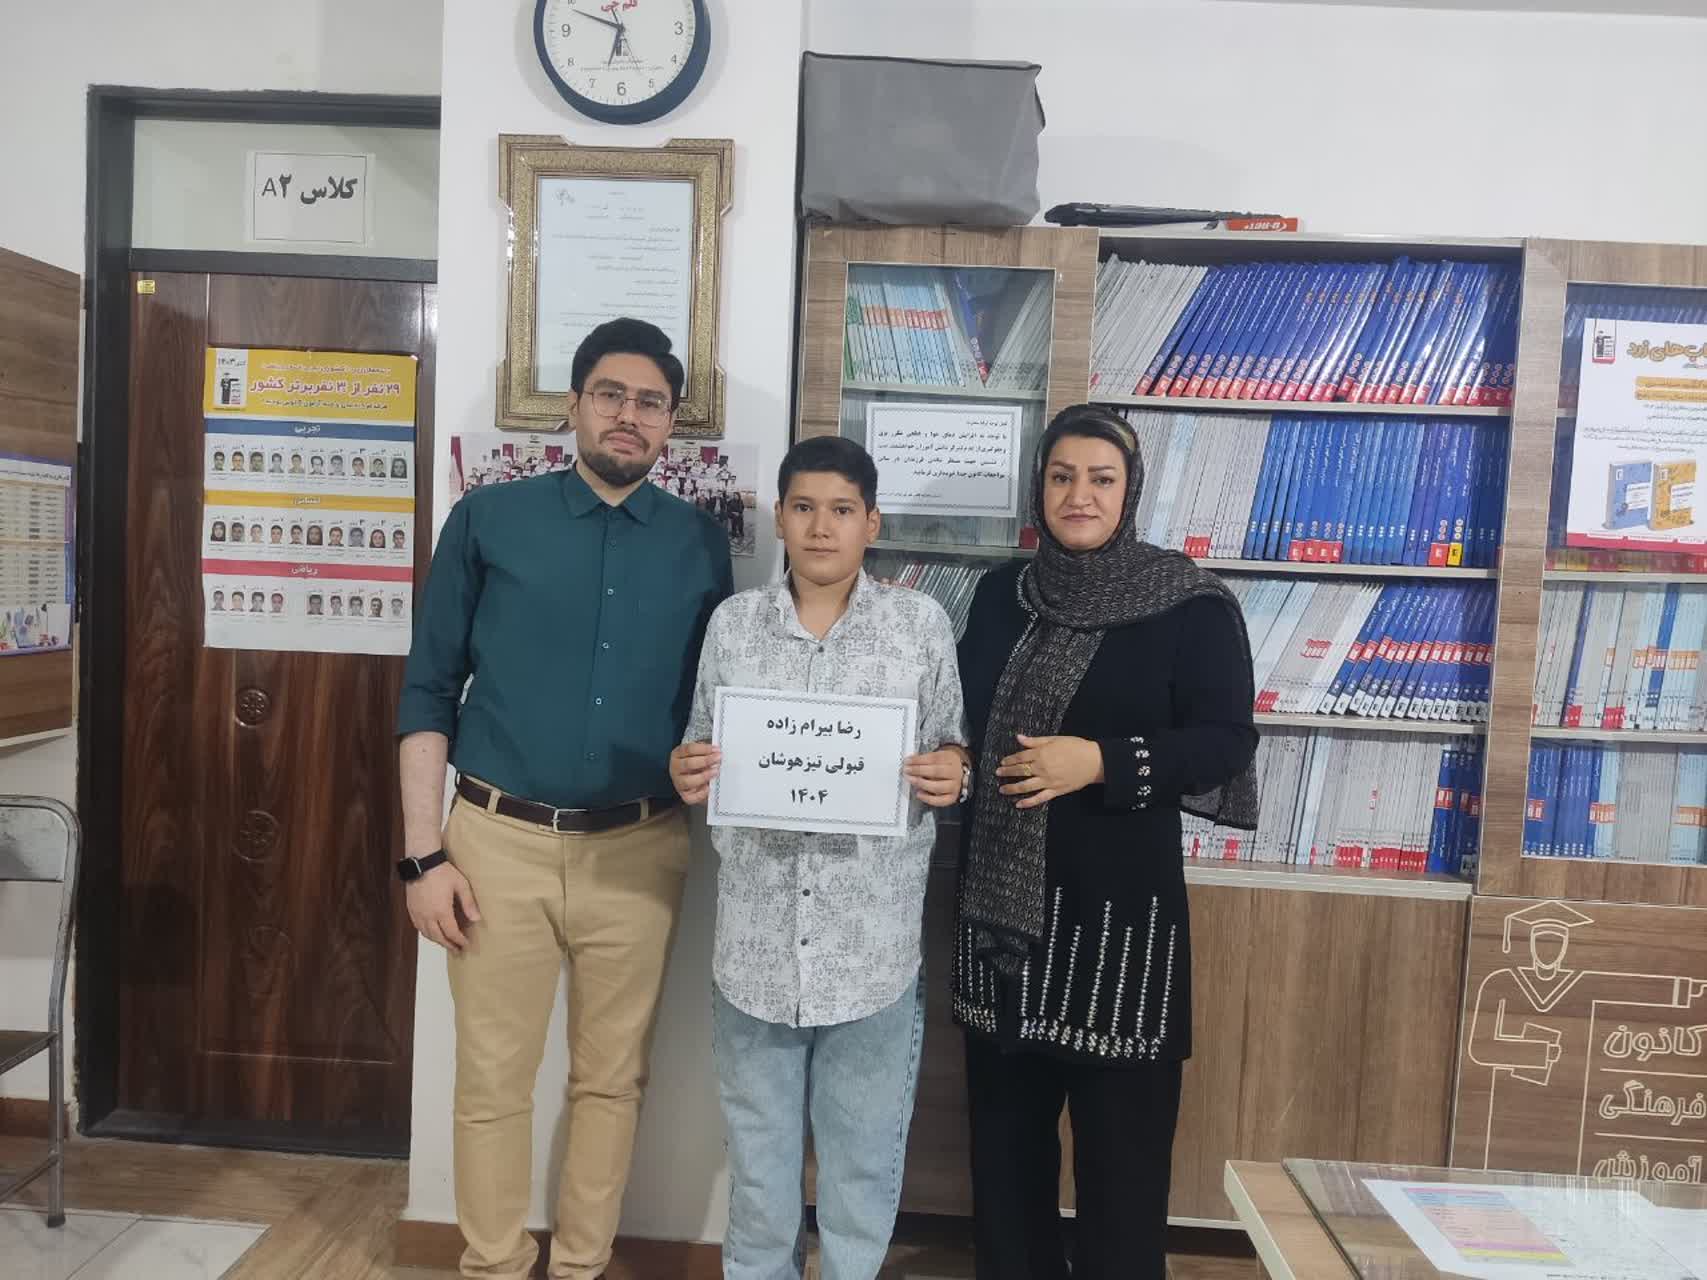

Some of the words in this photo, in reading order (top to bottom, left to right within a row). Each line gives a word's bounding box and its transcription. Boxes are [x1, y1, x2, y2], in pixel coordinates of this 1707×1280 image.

[561, 24, 572, 38] 9
[674, 22, 684, 36] 3
[567, 57, 575, 67] 8
[670, 54, 677, 65] 4
[589, 78, 596, 89] 7
[616, 81, 627, 97] 6
[300, 176, 358, 205] کلاس
[250, 377, 284, 392] کشور
[351, 381, 361, 396] از
[363, 383, 383, 396] نفر
[386, 383, 400, 395] ۲۹
[767, 716, 796, 735] زاده
[837, 721, 861, 739] رضا
[759, 752, 822, 772] تیزهوشان
[825, 757, 865, 775] قبولی
[791, 788, 829, 805] ۱۴۰۴
[1603, 1025, 1707, 1061] کانون
[1599, 1080, 1707, 1126] فرهنگی
[1593, 1151, 1703, 1184] آموزش
